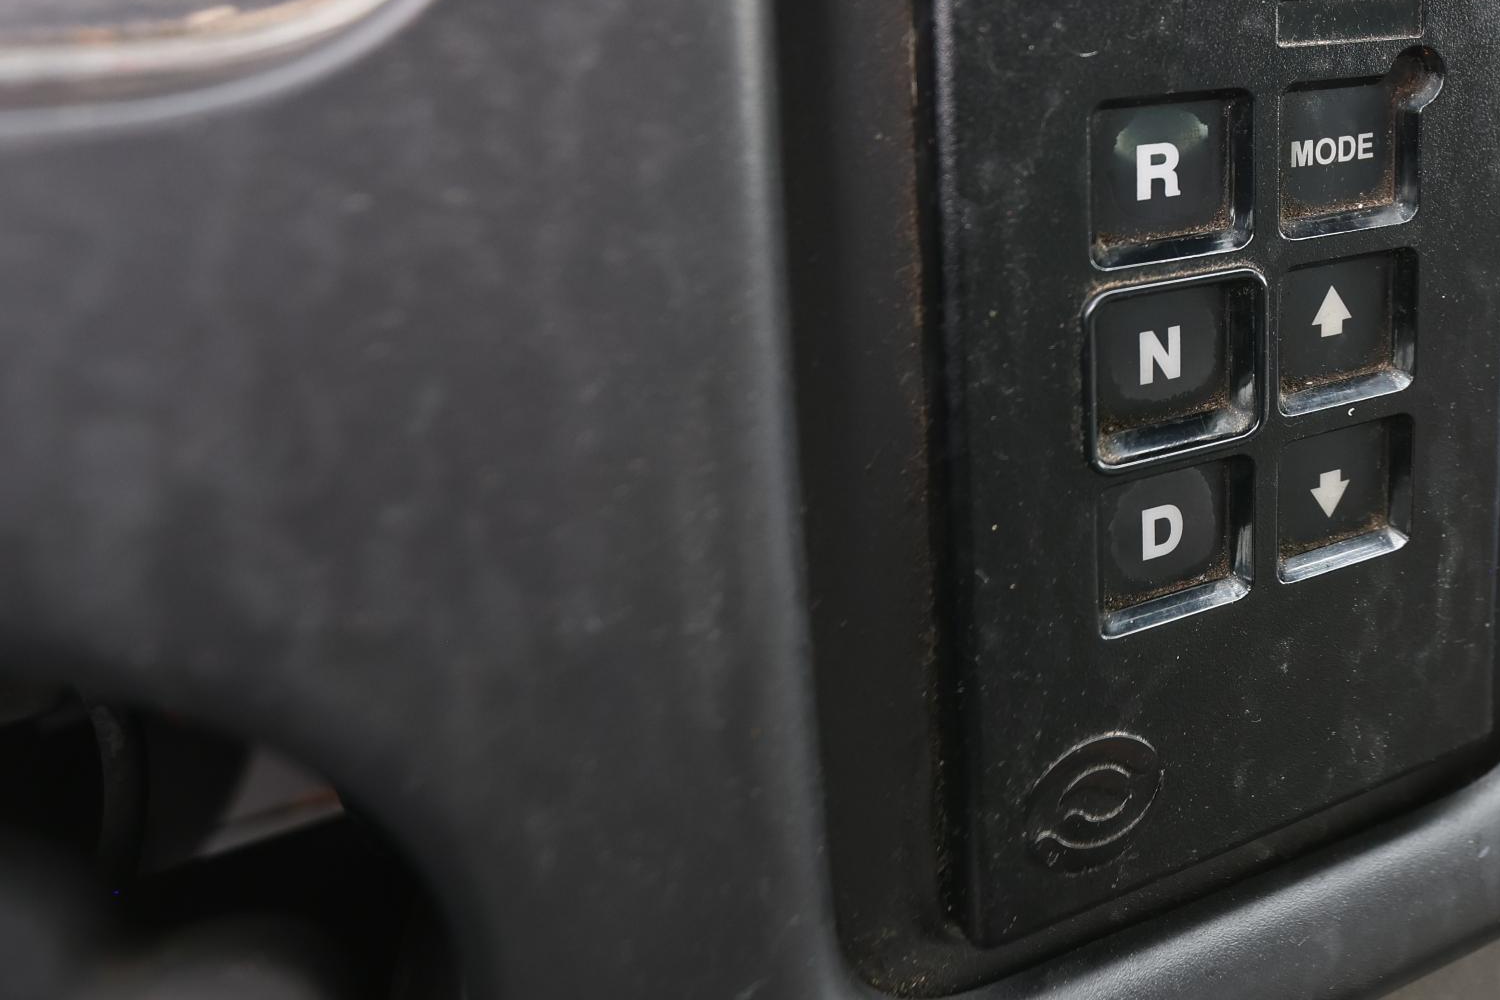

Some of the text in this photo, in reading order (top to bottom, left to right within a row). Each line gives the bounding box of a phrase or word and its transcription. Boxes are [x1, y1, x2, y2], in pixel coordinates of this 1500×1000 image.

[1135, 141, 1182, 202] R
[1290, 131, 1375, 170] MODE
[1138, 325, 1182, 386] N
[1141, 504, 1184, 562] D
